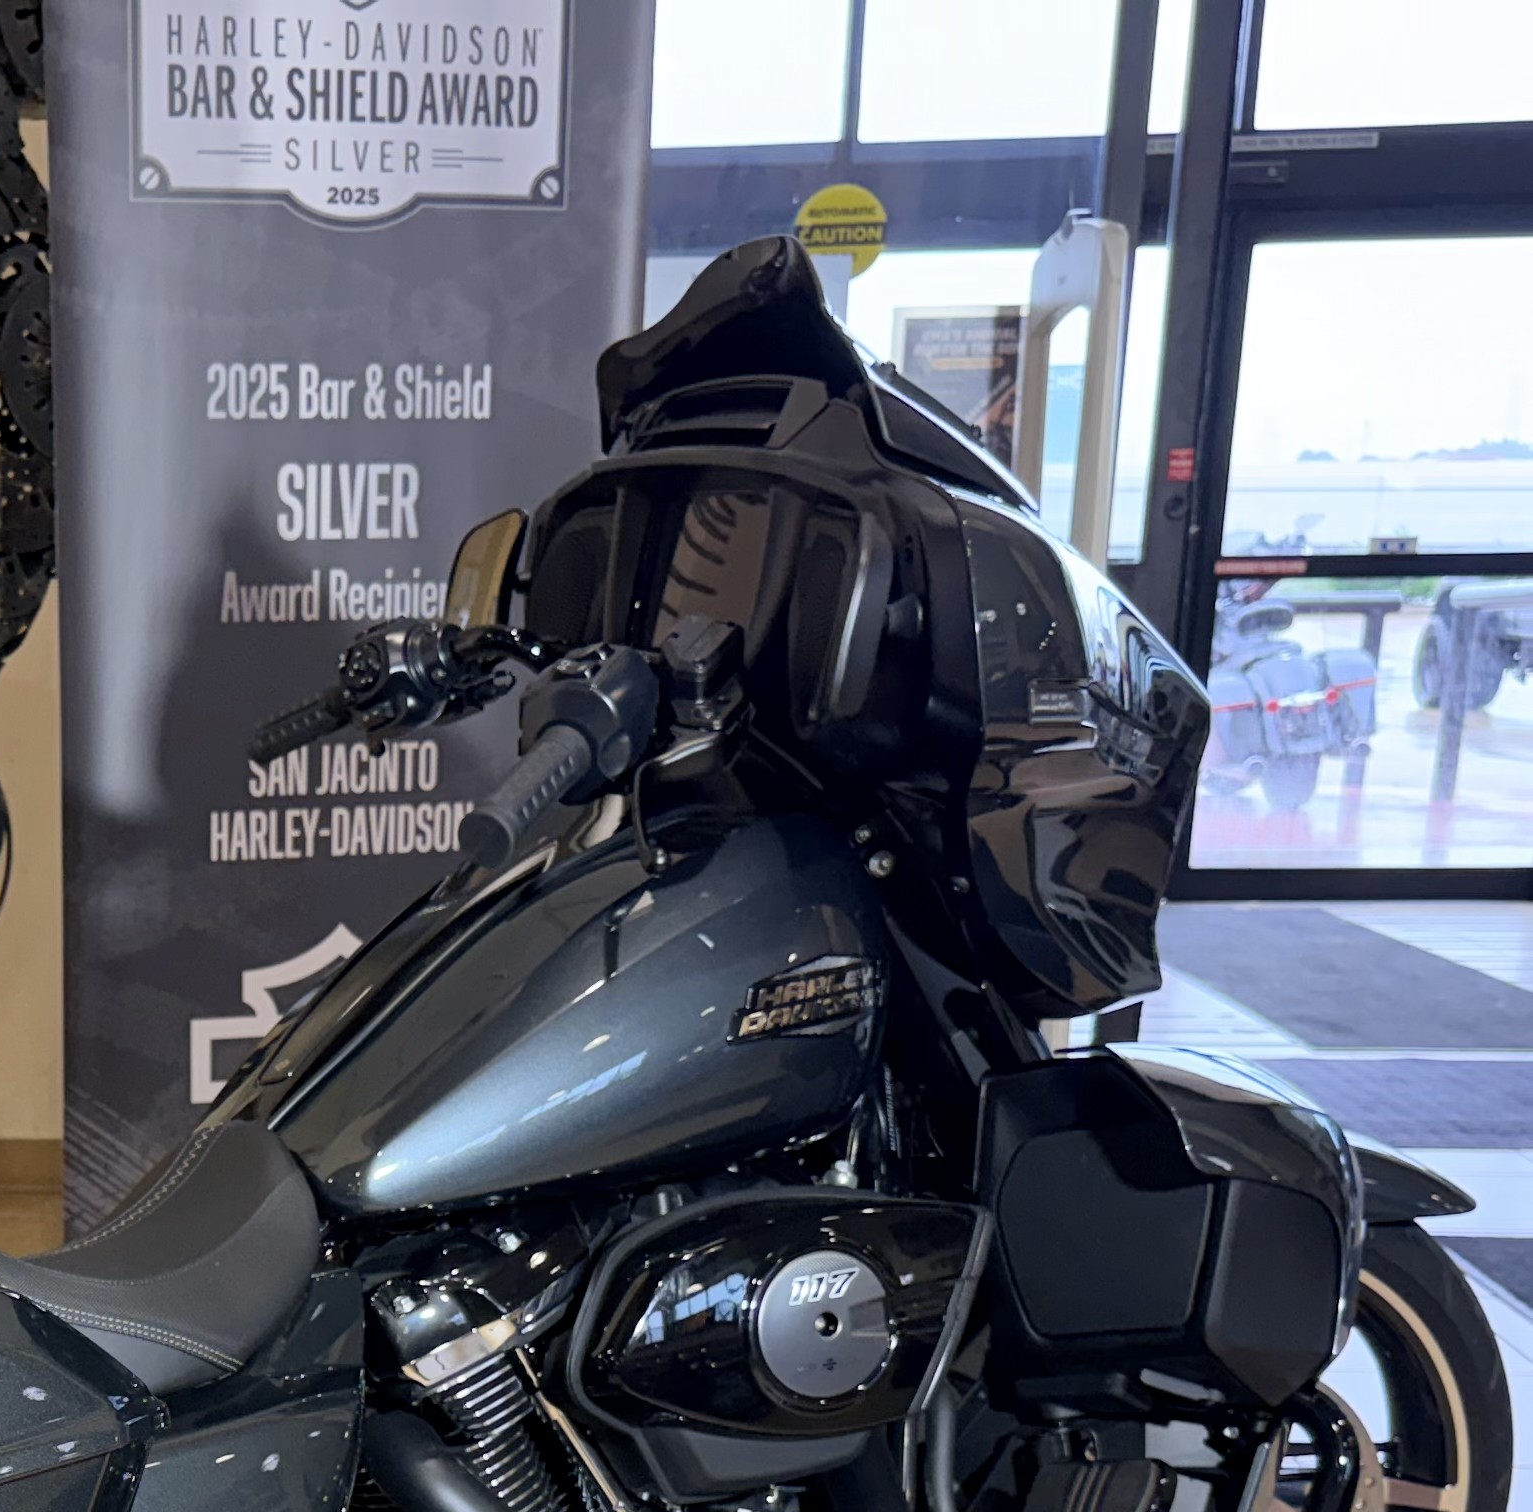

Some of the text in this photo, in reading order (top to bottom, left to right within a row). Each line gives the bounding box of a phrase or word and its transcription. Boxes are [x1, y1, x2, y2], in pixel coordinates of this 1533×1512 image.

[167, 14, 539, 67] HARLEY-DAVIDSON
[167, 63, 539, 128] BAR & SHIELD AWARD
[284, 137, 421, 173] SILVER
[327, 186, 380, 206] 2025
[798, 225, 883, 244] CAUTION
[206, 362, 492, 420] 2025 Bar & Shield
[277, 463, 419, 541] SILVER
[221, 568, 448, 624] Award Recipie
[248, 740, 439, 798] SAN JACINTO
[788, 1266, 861, 1307] 117
